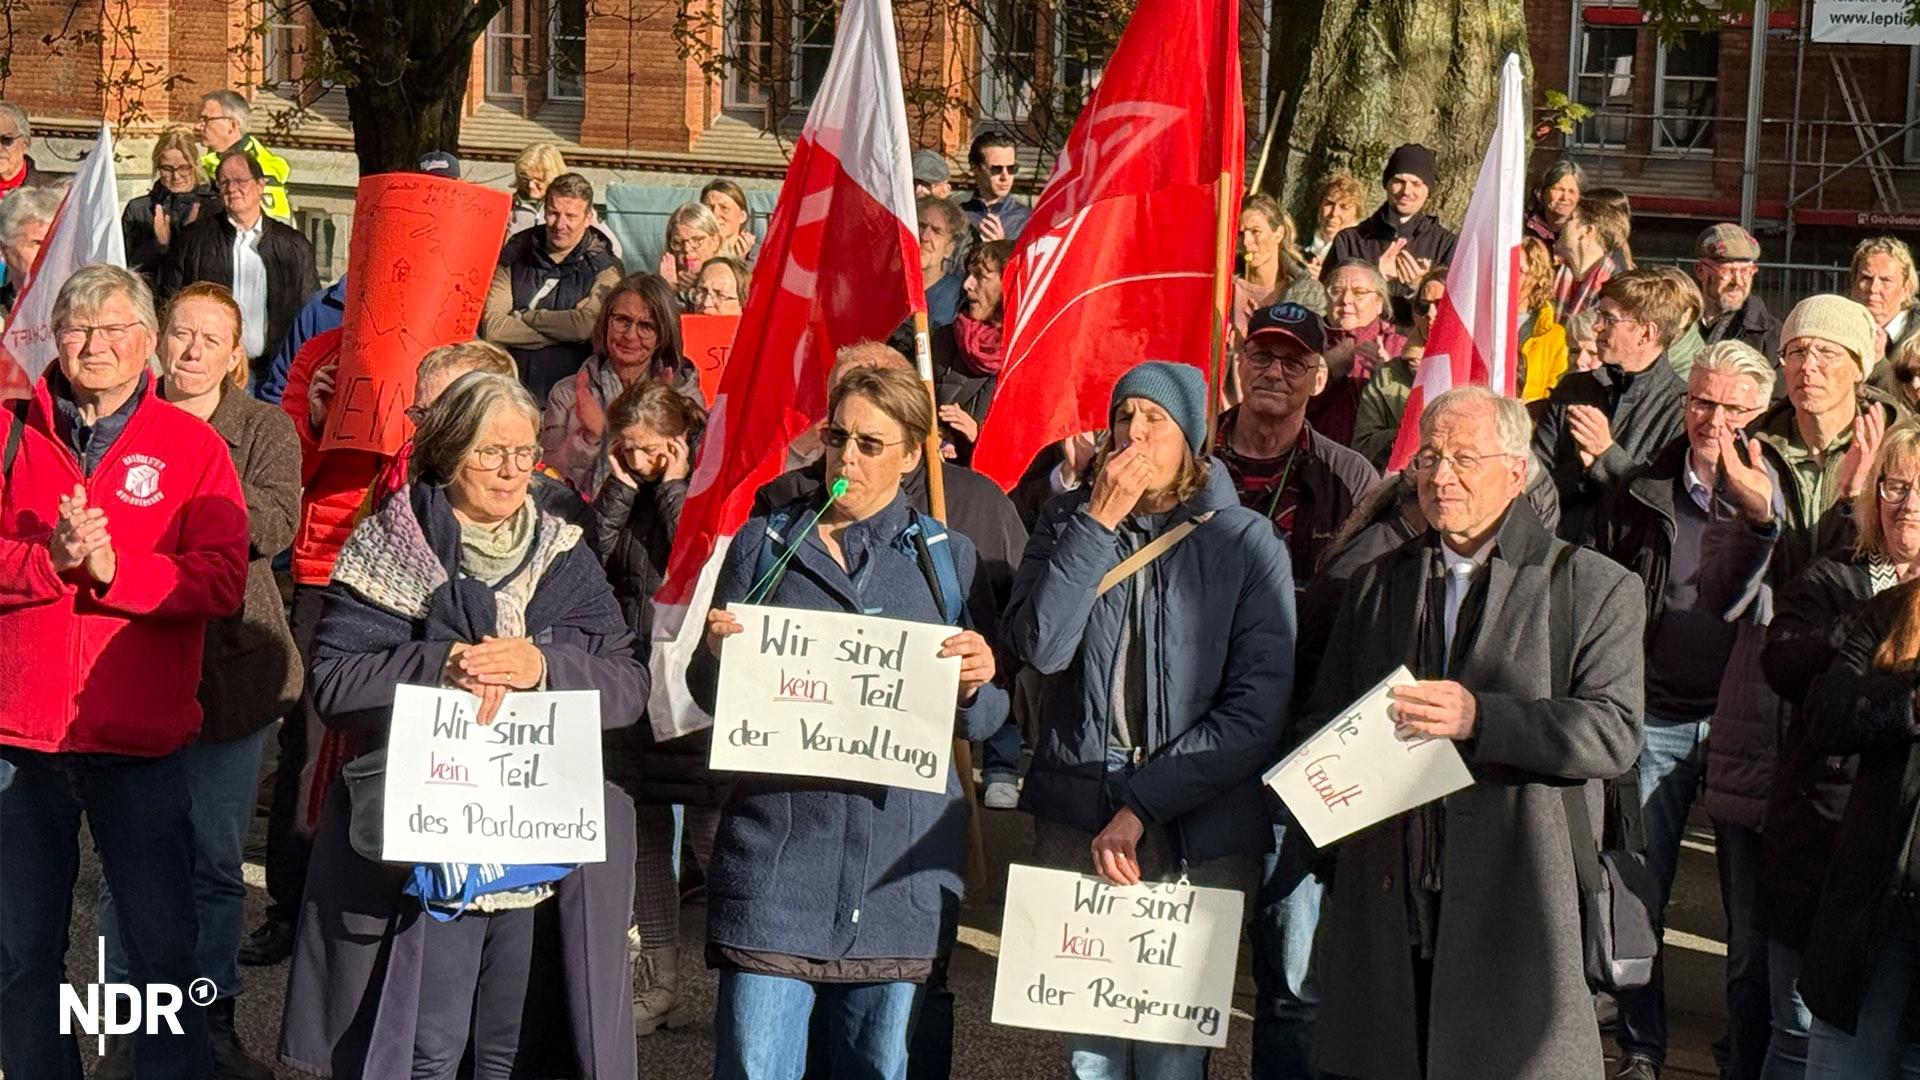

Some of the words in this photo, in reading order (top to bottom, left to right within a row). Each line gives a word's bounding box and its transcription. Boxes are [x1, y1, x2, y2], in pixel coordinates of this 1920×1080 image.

[759, 614, 818, 657] Wir
[833, 628, 909, 673] sind
[779, 668, 828, 701] kein
[851, 673, 908, 712] Teil
[433, 696, 476, 740] Wir
[485, 702, 557, 746] sind
[430, 750, 469, 782] kein
[488, 752, 549, 788] Teil
[728, 719, 779, 747] der
[799, 717, 938, 780] Verwaltung
[408, 804, 449, 834] des
[462, 802, 598, 842] Parlaments
[1073, 880, 1127, 916] Wir
[1131, 889, 1196, 924] sind
[1061, 922, 1105, 957] kein
[1128, 929, 1182, 968] Teil
[1026, 973, 1076, 1007] der
[1086, 977, 1221, 1036] Regierung
